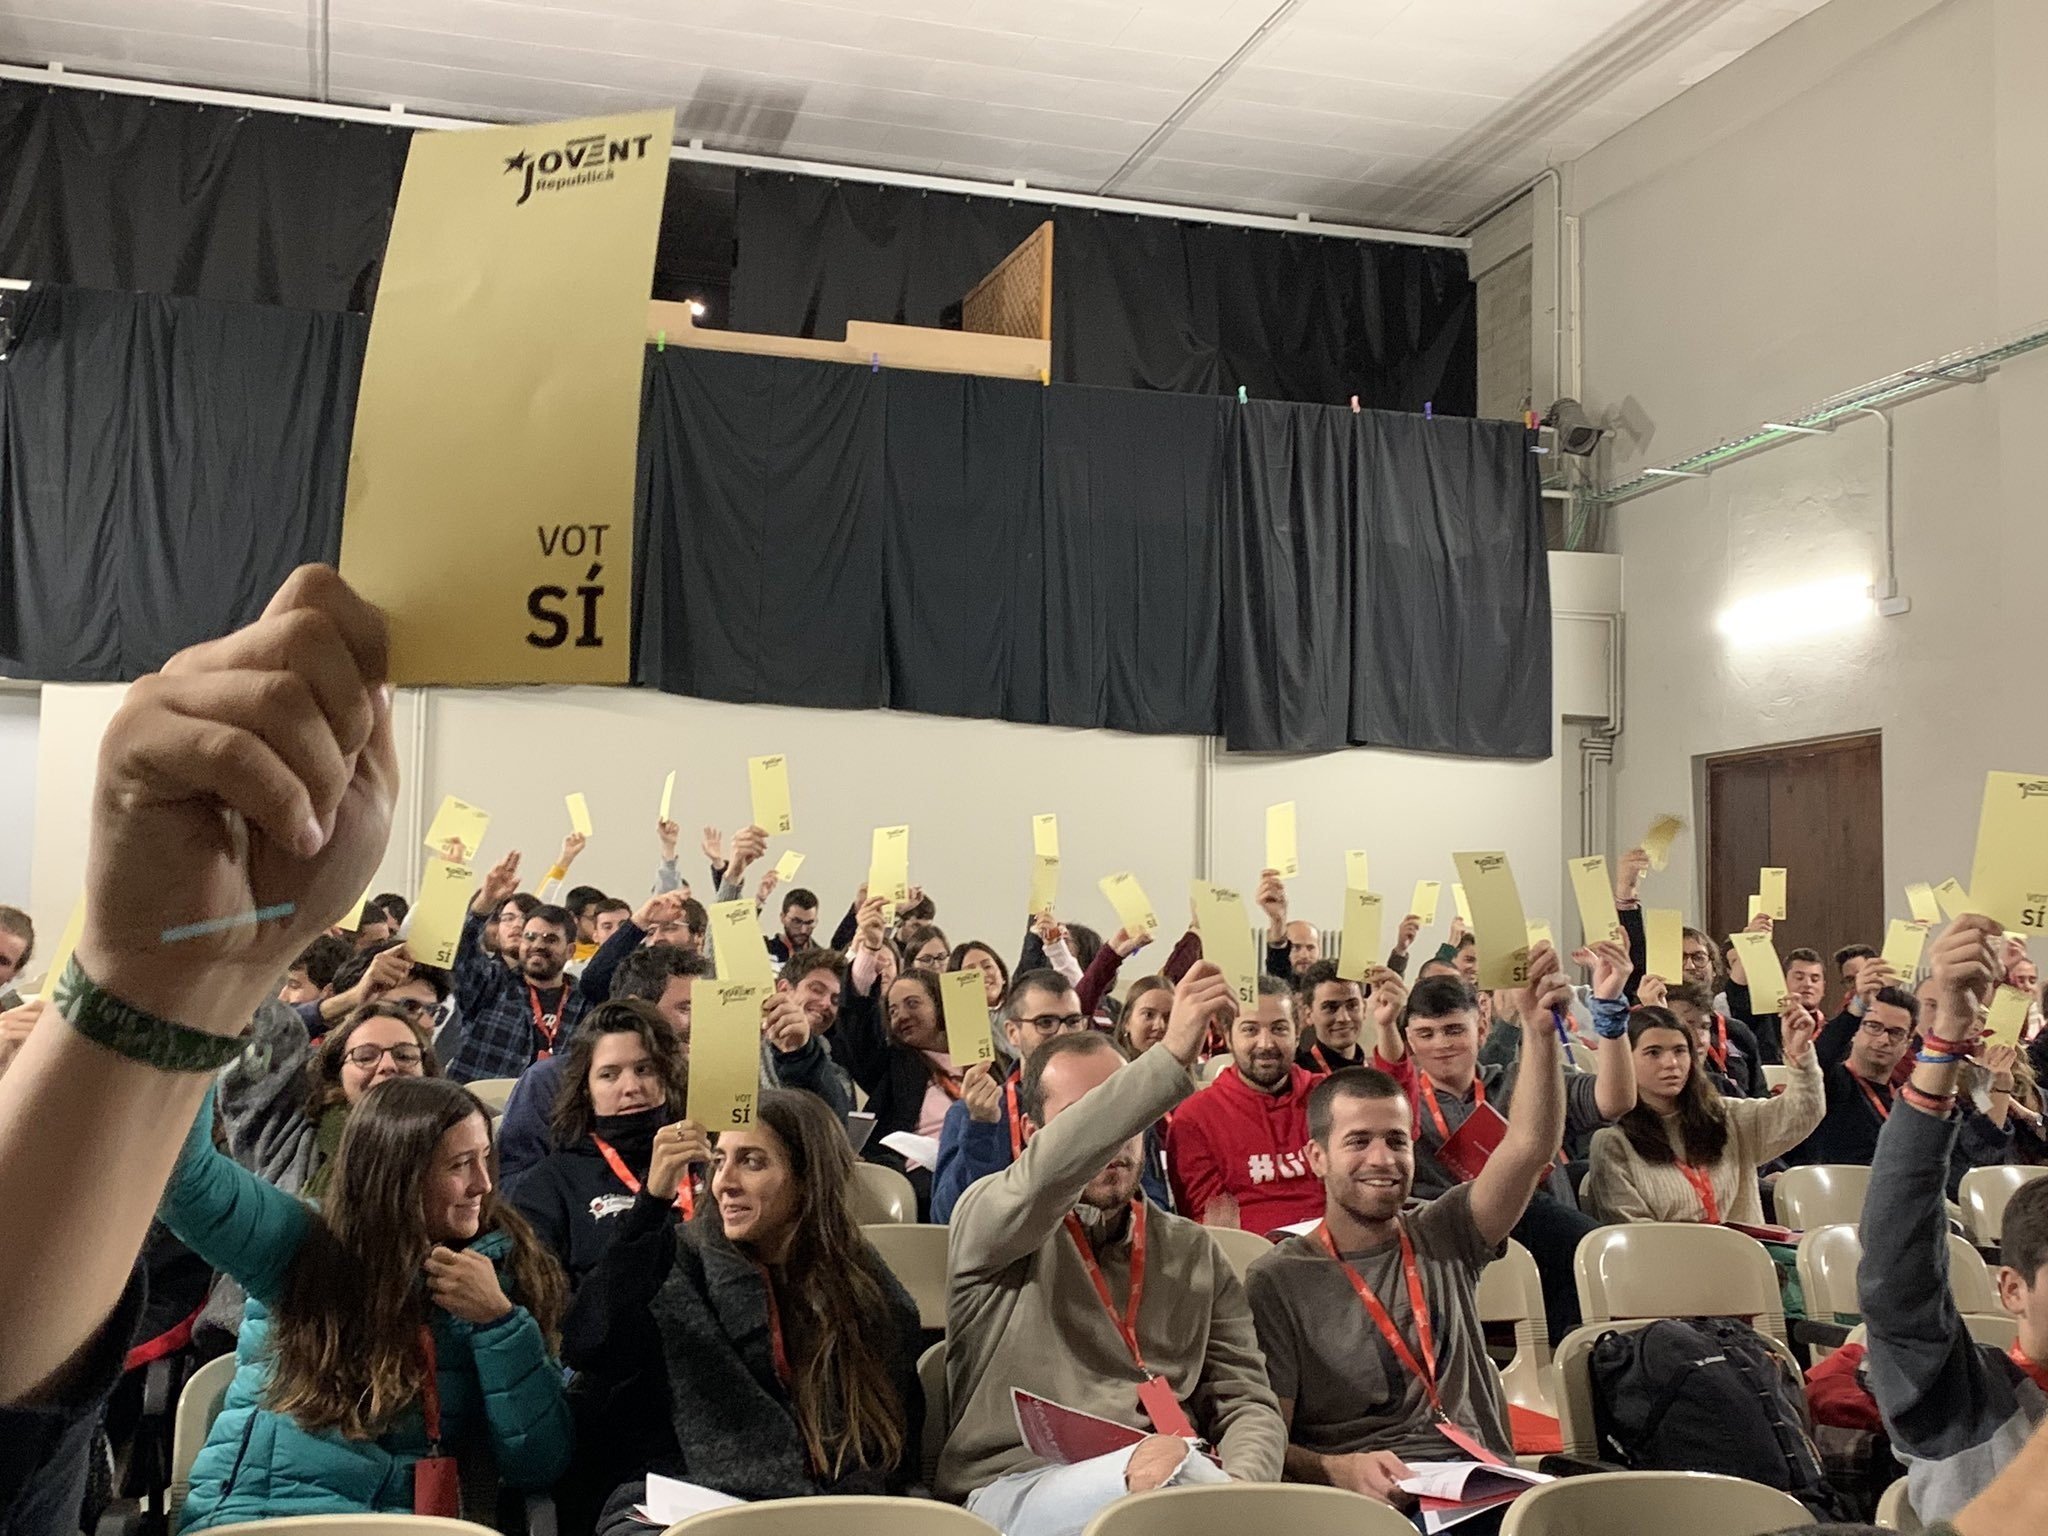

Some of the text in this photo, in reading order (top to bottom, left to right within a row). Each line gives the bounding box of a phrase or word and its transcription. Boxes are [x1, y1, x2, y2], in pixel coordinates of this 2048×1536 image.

[516, 134, 653, 207] JOVENT
[537, 524, 610, 557] VOT
[525, 561, 604, 649] SÍ
[2020, 905, 2046, 928] SÍ
[1512, 962, 1528, 982] SÍ
[1240, 985, 1254, 1004] SÍ
[978, 1043, 991, 1059] SÍ
[734, 1093, 752, 1103] VOT
[731, 1103, 751, 1124] SÍ
